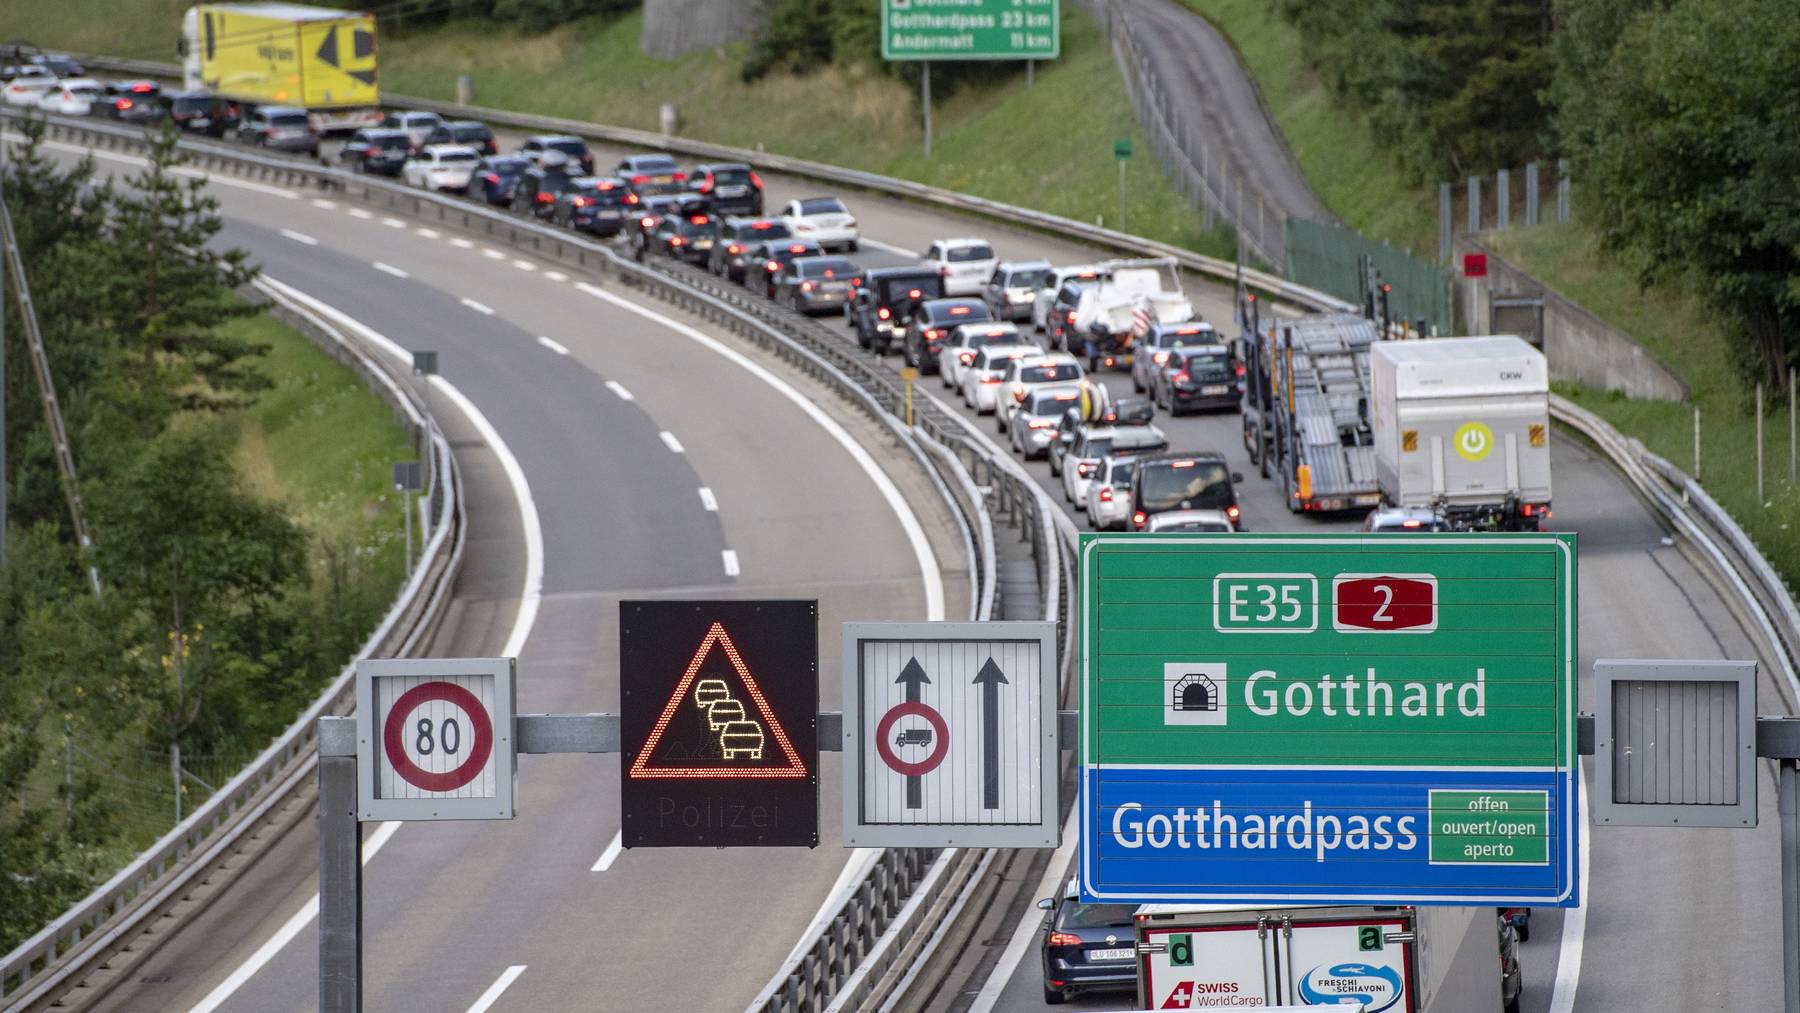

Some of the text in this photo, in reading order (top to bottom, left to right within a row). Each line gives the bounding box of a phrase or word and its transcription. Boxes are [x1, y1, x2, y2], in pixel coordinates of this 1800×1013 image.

[891, 11, 1050, 30] Gotthardpass 23 km
[892, 33, 1050, 48] Andermatt 11 km
[1229, 584, 1394, 622] E35 2
[1244, 667, 1485, 717] Gotthard
[416, 717, 460, 755] 80
[657, 797, 779, 828] Polizei
[1468, 797, 1509, 813] offen
[1112, 800, 1418, 862] Gotthardpass
[1441, 819, 1537, 838] ouvert/open
[1463, 843, 1514, 860] aperto
[1360, 926, 1381, 950] a
[1171, 935, 1193, 965] d
[1197, 982, 1239, 994] SWISS
[1318, 979, 1357, 987] FRESCHI
[1336, 985, 1385, 993] SCHIAVONI
[1197, 995, 1263, 1007] WorldCargo
